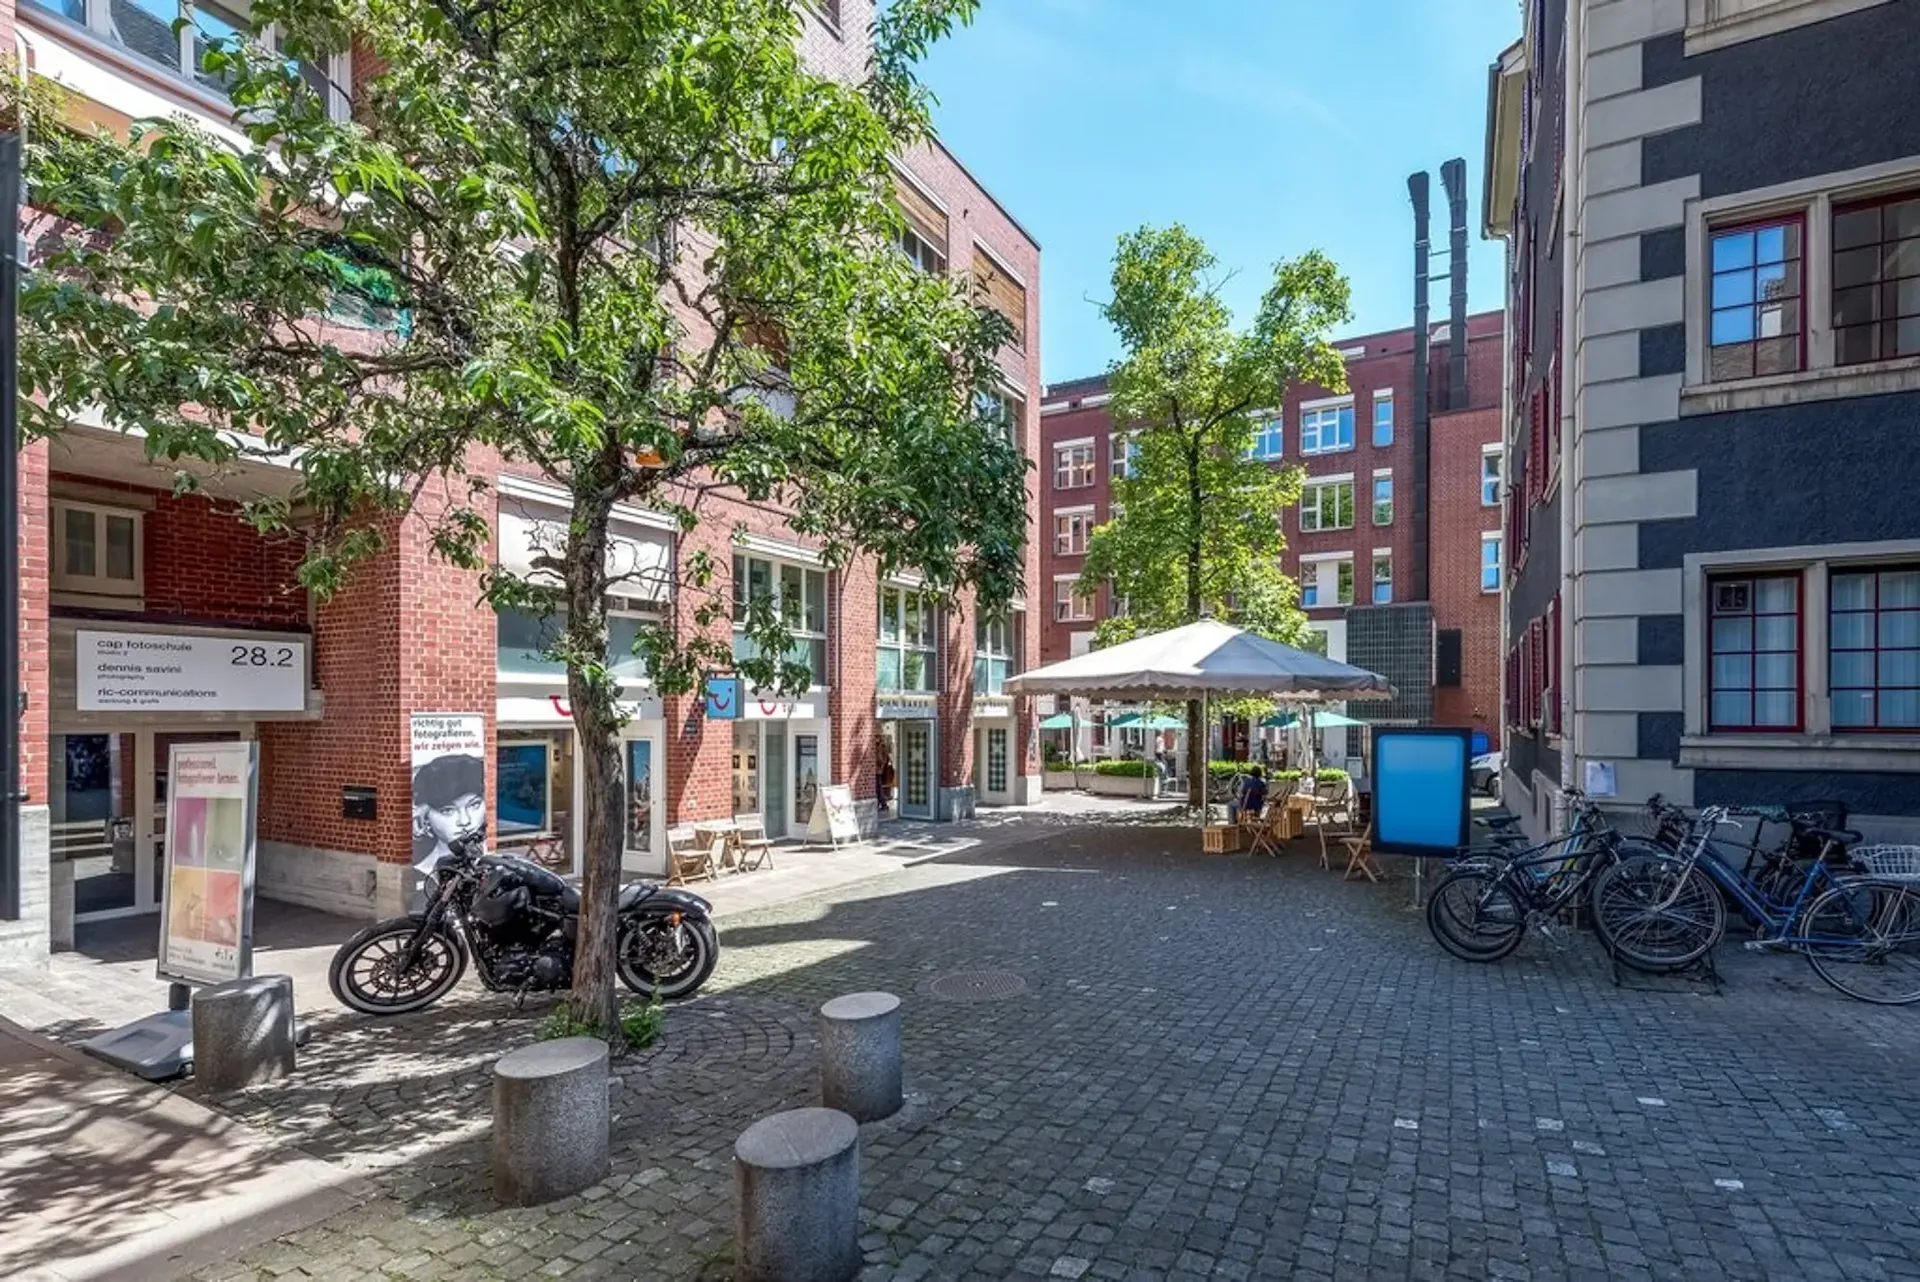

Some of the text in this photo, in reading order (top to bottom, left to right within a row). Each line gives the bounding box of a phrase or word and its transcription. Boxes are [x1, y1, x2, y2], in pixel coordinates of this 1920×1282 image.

[97, 640, 193, 652] cap fotoschule
[231, 646, 293, 668] 28.2
[97, 664, 182, 674] dennis savini
[97, 687, 217, 698] ric-communications
[413, 719, 463, 729] richtig gut
[414, 742, 429, 751] wir
[431, 742, 462, 752] zeigen
